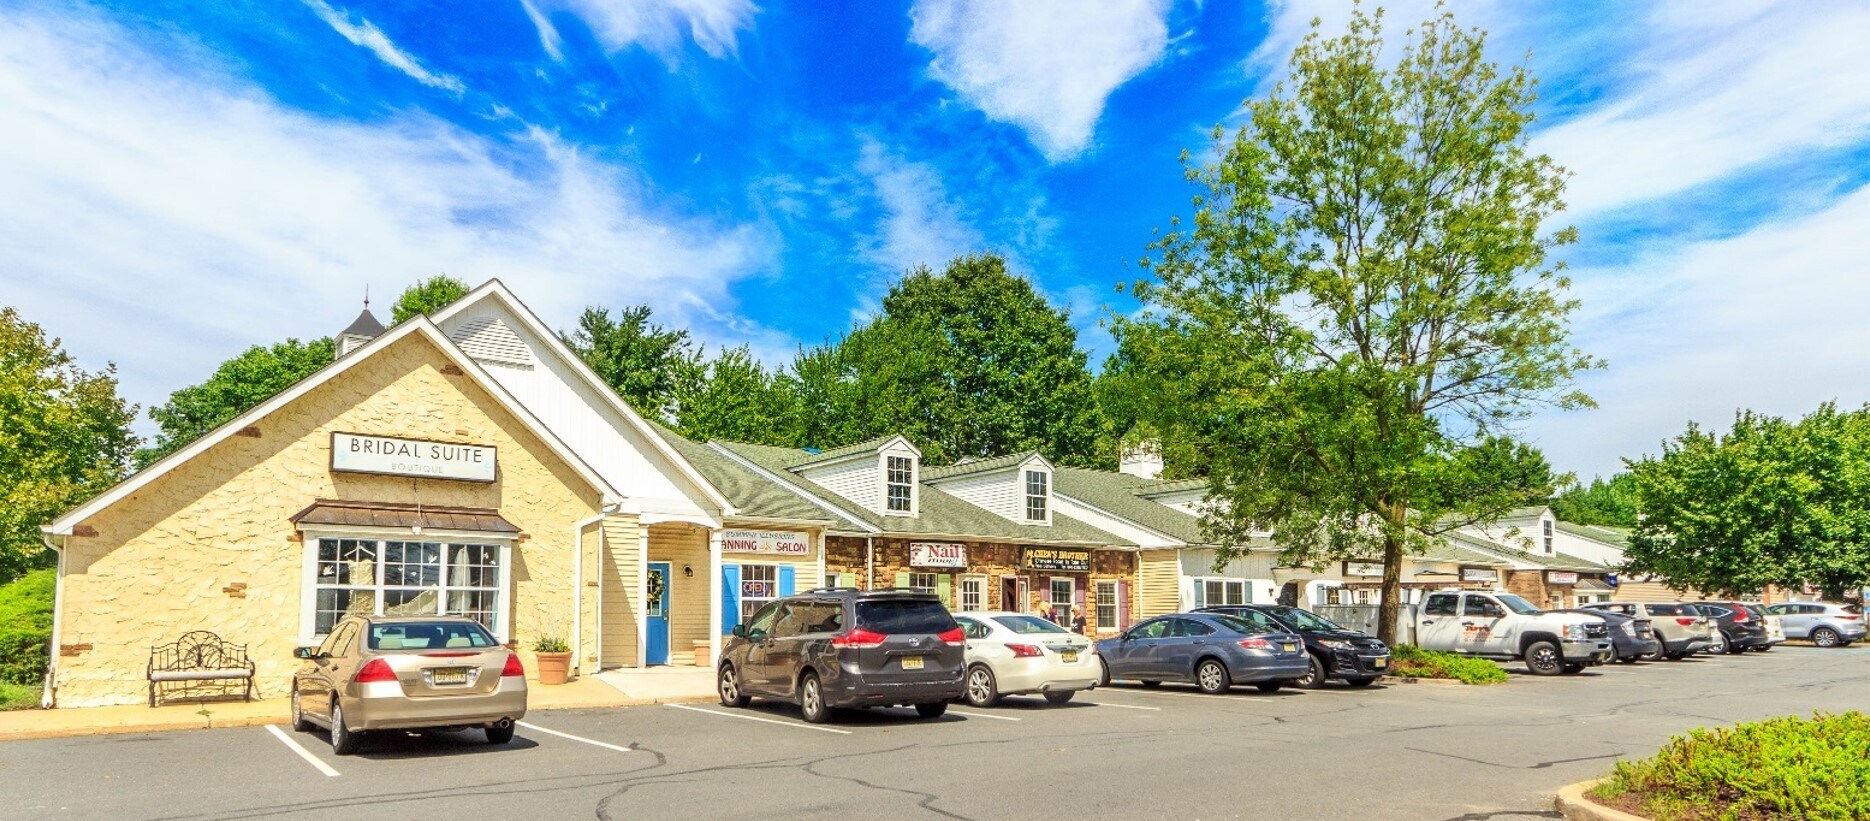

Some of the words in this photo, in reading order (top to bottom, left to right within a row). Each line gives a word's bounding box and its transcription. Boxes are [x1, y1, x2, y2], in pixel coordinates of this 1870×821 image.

[350, 438, 421, 458] BRIDAL
[430, 445, 482, 463] SUITE
[391, 462, 444, 474] BOUTIQUE
[721, 539, 757, 551] ANNING
[776, 541, 807, 553] SALON
[927, 544, 960, 559] Nail
